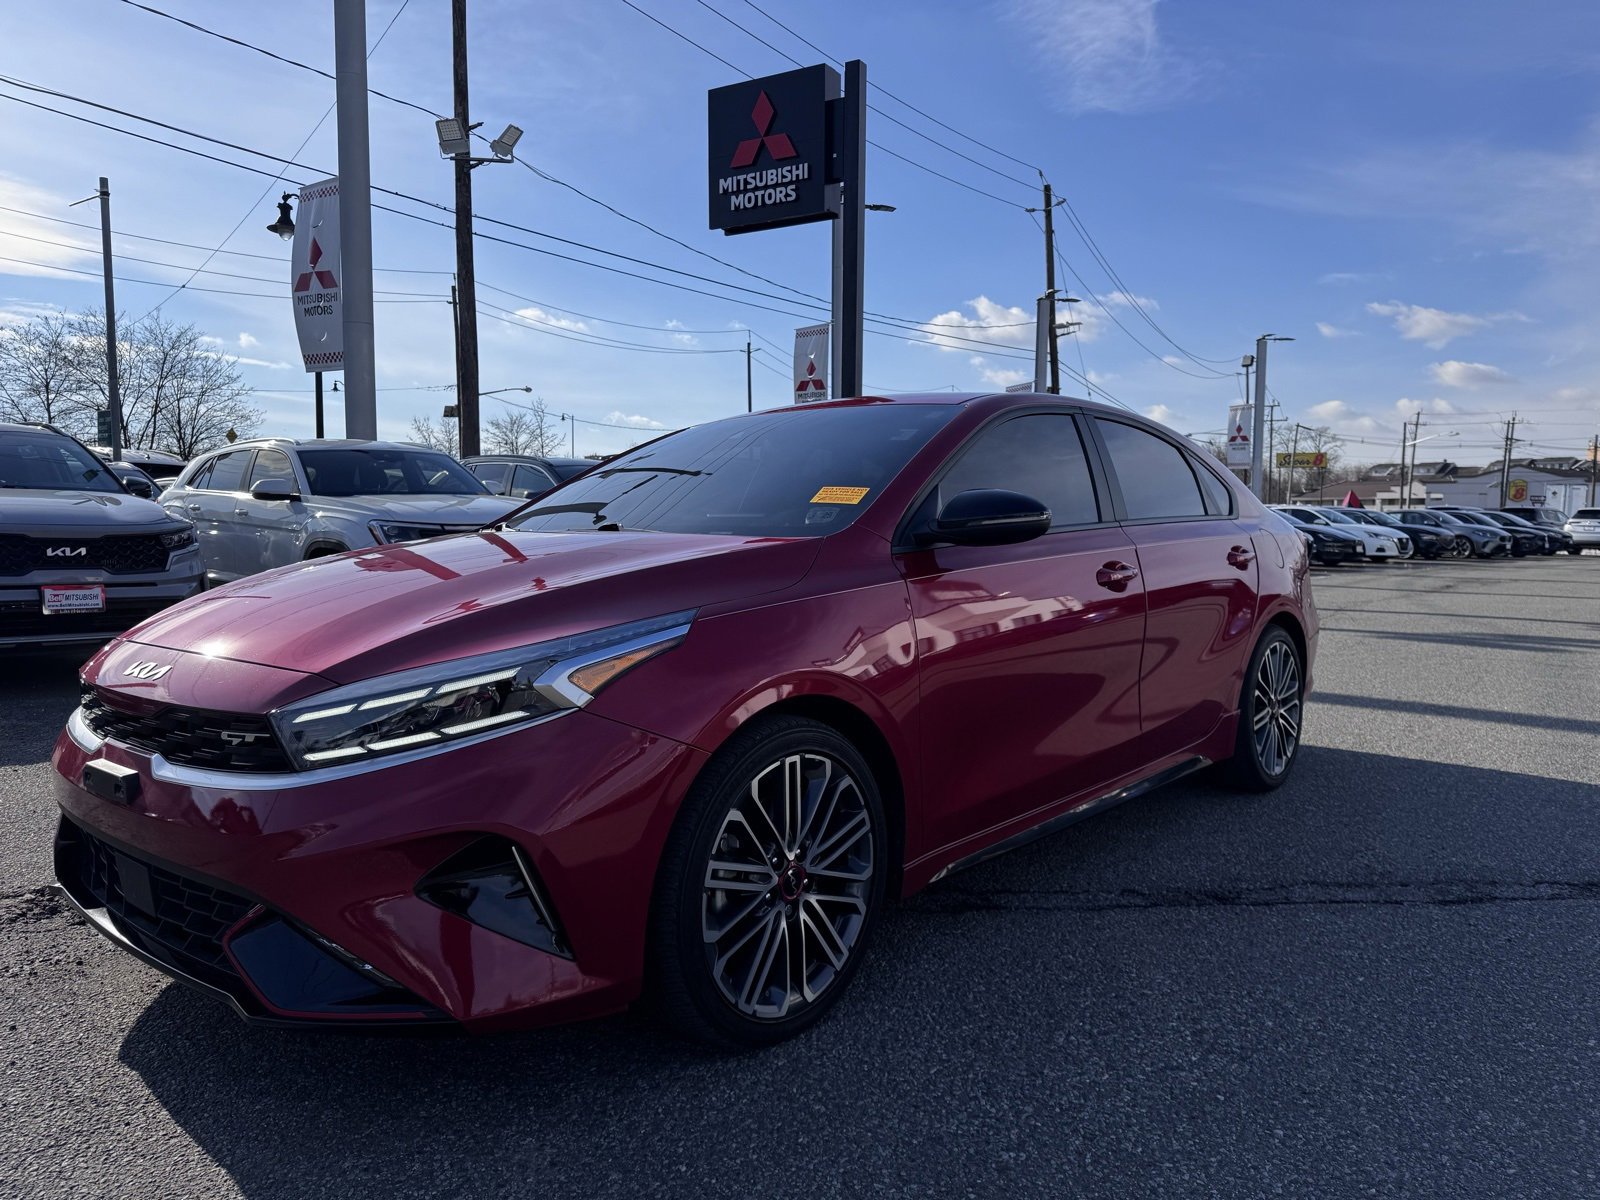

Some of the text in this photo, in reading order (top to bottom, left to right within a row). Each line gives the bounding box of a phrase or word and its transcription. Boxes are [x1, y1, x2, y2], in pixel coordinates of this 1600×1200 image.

[719, 163, 808, 193] MITSUBISHI
[731, 184, 796, 210] MOTORS
[298, 292, 338, 305] MITSUBISHI
[304, 305, 334, 317] MOTORS
[1312, 453, 1324, 466] 8
[46, 547, 87, 557] KIA
[48, 593, 99, 602] Bell MITSUBISHI
[123, 660, 172, 681] KIA
[220, 731, 271, 746] GT
